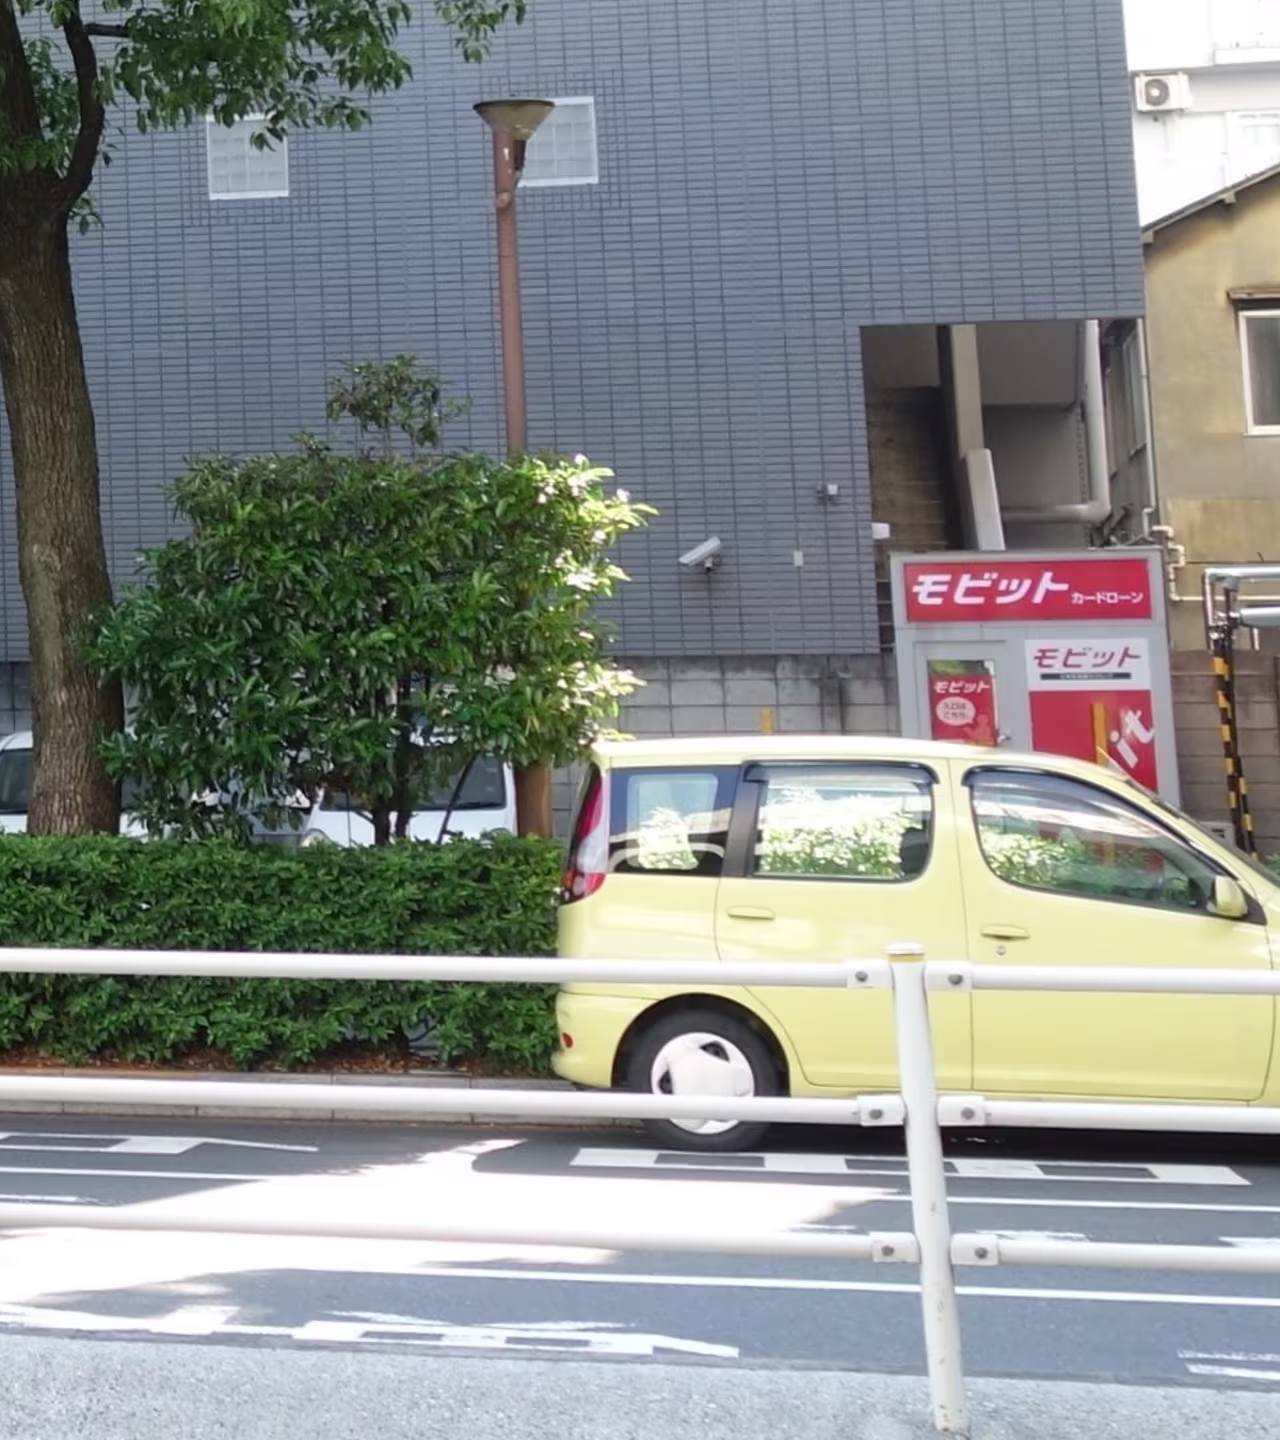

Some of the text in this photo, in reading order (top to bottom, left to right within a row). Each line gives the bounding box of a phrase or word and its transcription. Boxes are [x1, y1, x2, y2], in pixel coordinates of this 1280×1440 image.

[912, 571, 1144, 605] モビット カードローン
[1033, 646, 1142, 669] モビット
[934, 680, 990, 694] モビット
